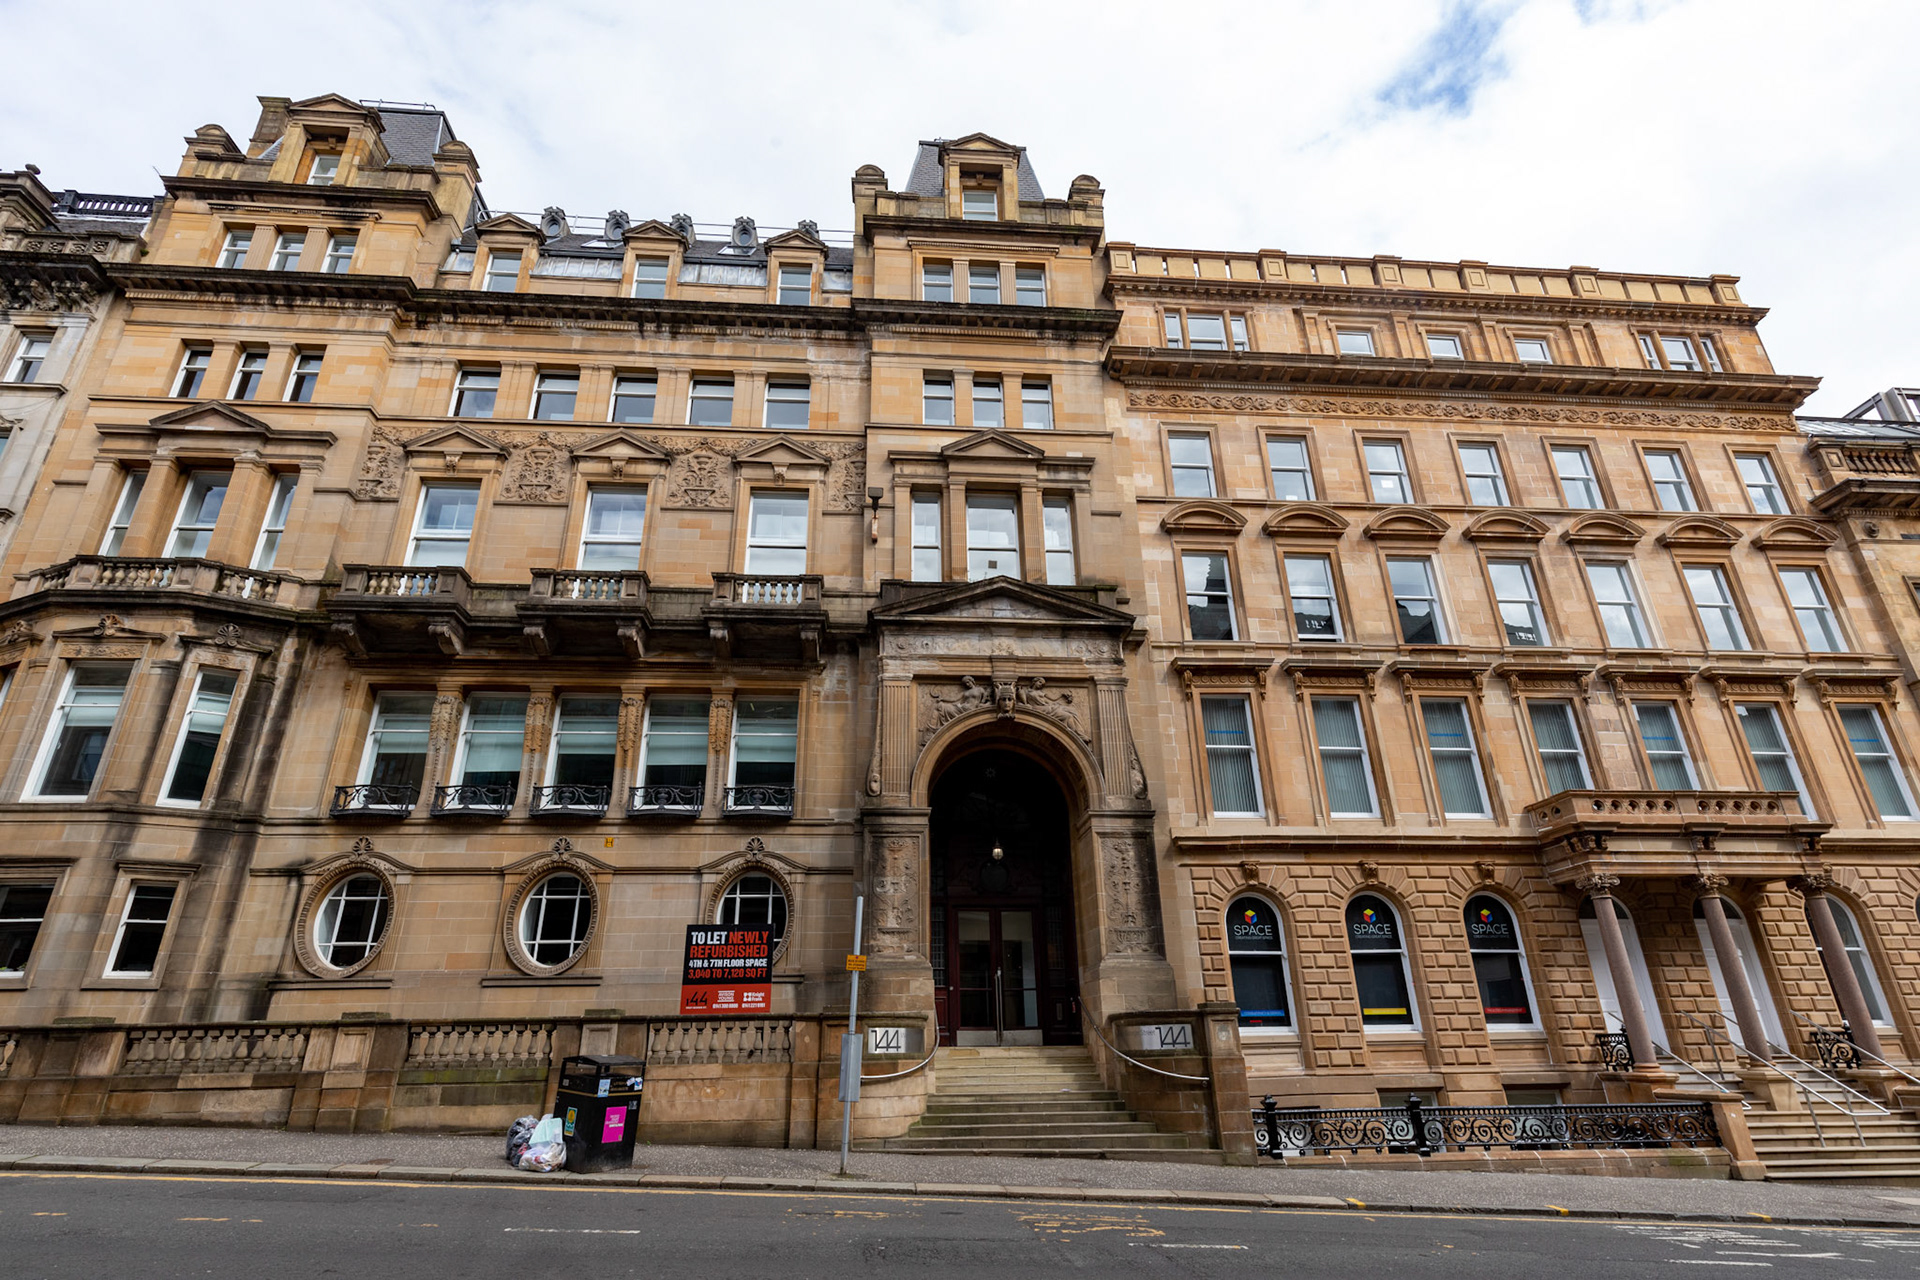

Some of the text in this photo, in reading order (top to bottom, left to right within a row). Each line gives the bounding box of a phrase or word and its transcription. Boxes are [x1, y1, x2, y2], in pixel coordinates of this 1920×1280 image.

[1233, 925, 1273, 936] SPACE
[1353, 923, 1392, 935] SPACE
[1471, 923, 1509, 935] SPACE
[691, 931, 769, 945] TO LET NEWLY
[689, 944, 769, 958] REFURBISHED
[689, 958, 768, 968] 4TH & 7TH FLOOR SPACE
[687, 968, 768, 980] 3,040 TO 7,120 SQ FT
[686, 991, 708, 1006] 144
[871, 1029, 901, 1051] 144
[1155, 1026, 1190, 1048] 144
